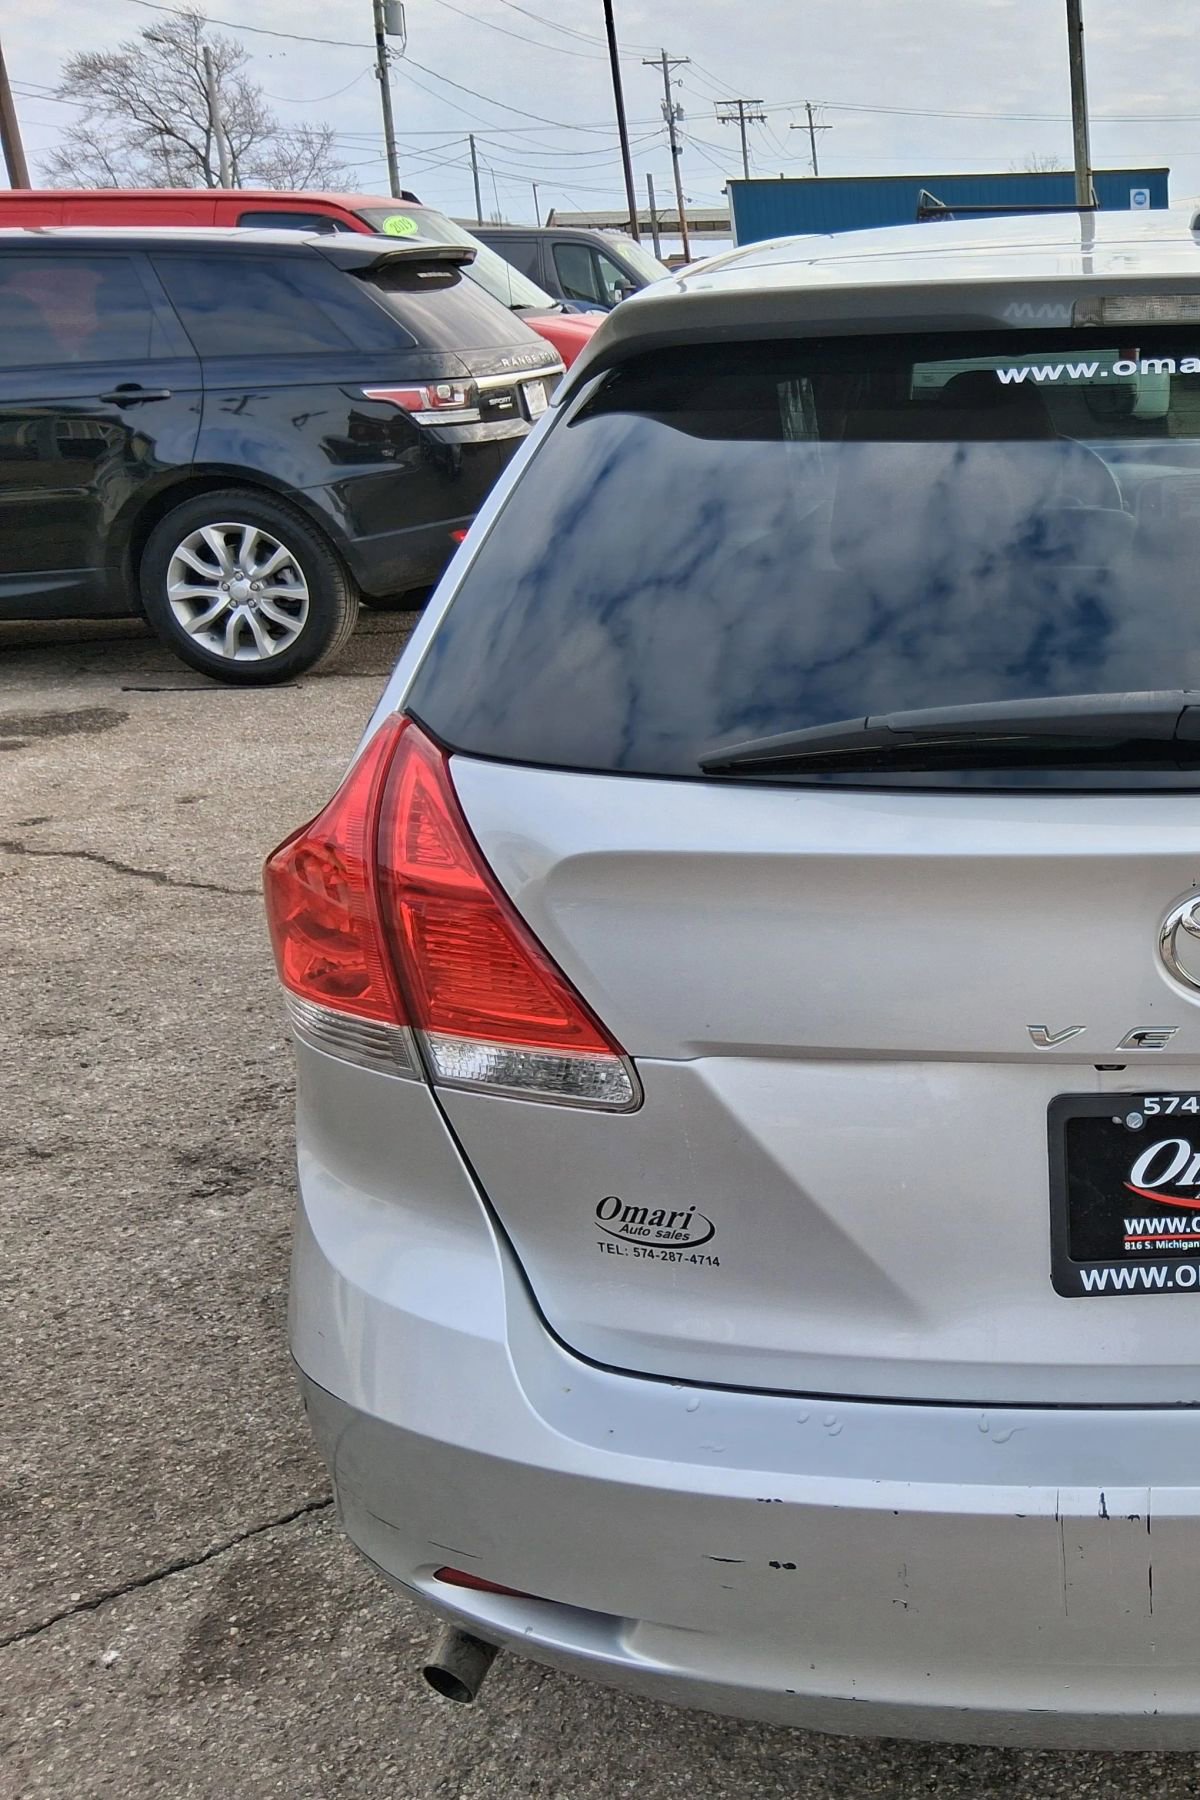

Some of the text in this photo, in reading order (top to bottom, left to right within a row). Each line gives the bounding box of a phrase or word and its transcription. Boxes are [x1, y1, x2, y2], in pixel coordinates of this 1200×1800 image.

[501, 354, 537, 367] RANGE
[595, 1195, 697, 1230] Omari
[618, 1223, 691, 1241] Auto sales
[597, 1241, 721, 1267] TEL: 574-287-4714
[1124, 1241, 1142, 1251] 816
[1144, 1241, 1154, 1250] S.
[1155, 1239, 1200, 1251] Michigan
